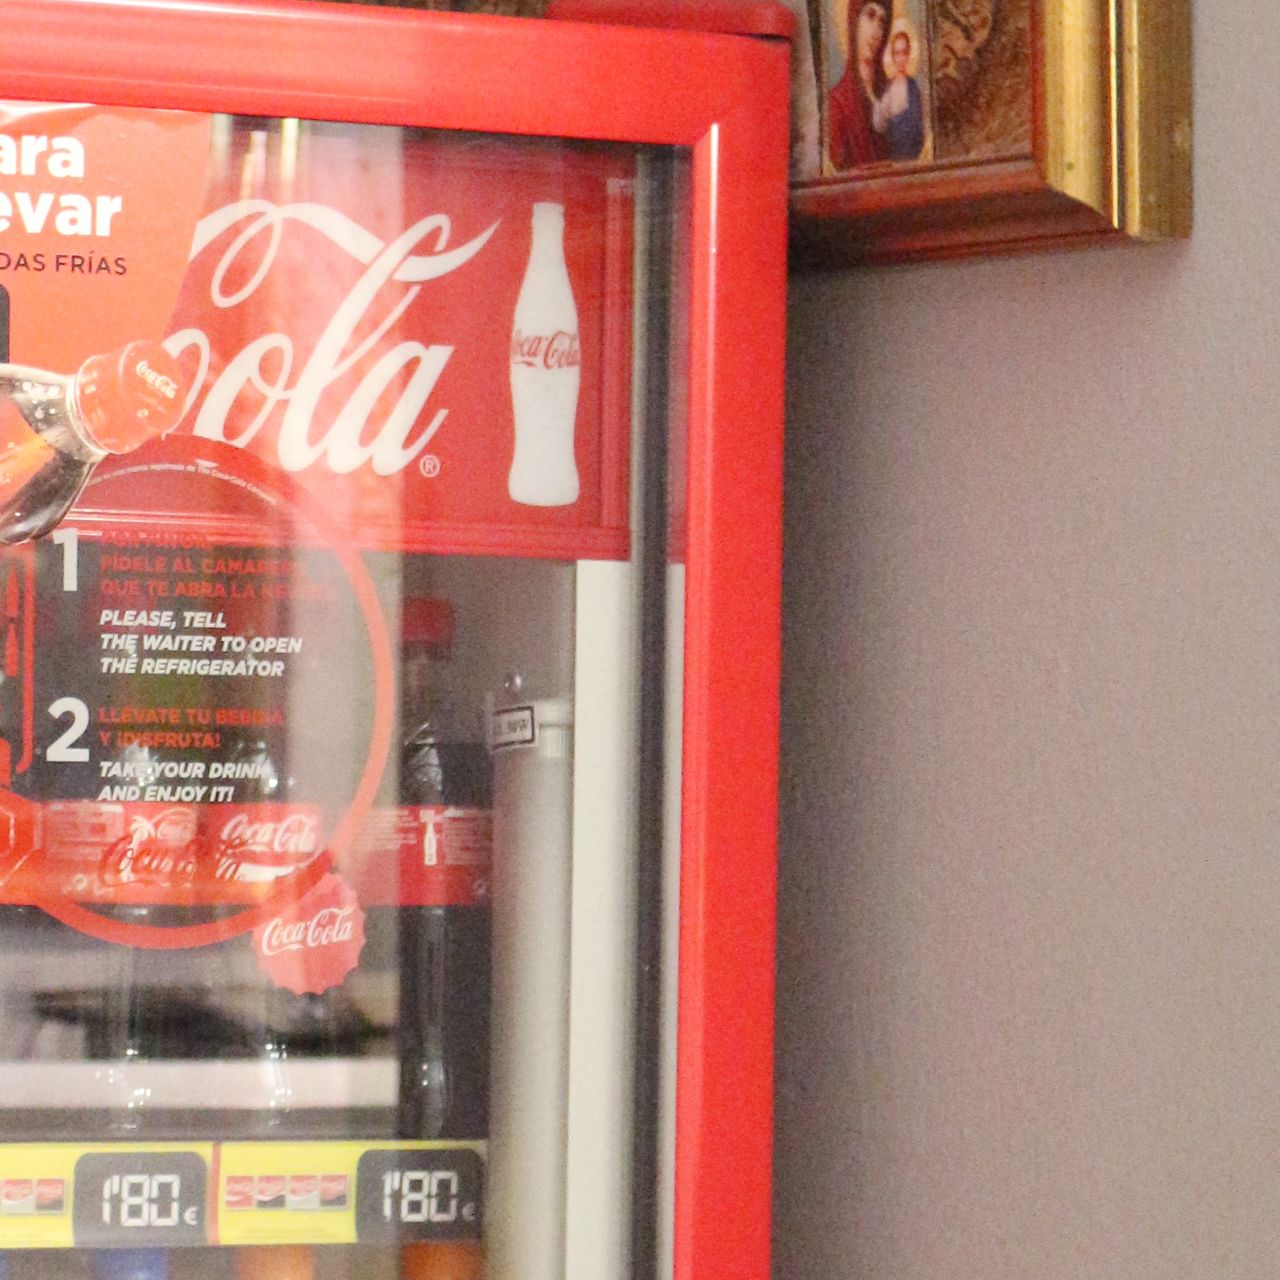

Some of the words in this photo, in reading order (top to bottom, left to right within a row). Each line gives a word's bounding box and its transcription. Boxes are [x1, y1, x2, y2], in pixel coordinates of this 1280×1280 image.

[55, 250, 128, 276] FRÍAS
[512, 328, 580, 371] ca-Cola
[53, 527, 78, 592] 1
[203, 557, 308, 577] CAMARE
[101, 579, 140, 596] QUE
[100, 609, 177, 630] PLEASE,
[183, 611, 227, 629] TELL
[100, 633, 138, 650] THE
[143, 634, 217, 652] WAITER
[221, 636, 247, 653] TO
[250, 637, 303, 654] OPEN
[100, 657, 138, 674] THE
[141, 658, 285, 677] REFRIGERATOR
[186, 708, 210, 724] TU
[46, 697, 90, 762] 2
[100, 731, 111, 747] Y
[154, 762, 206, 779] YOUR
[209, 762, 269, 779] DRINK
[97, 785, 141, 801] AND
[144, 786, 207, 802] ENJOY
[209, 786, 235, 802] IT!
[261, 903, 356, 958] Coca-Cola
